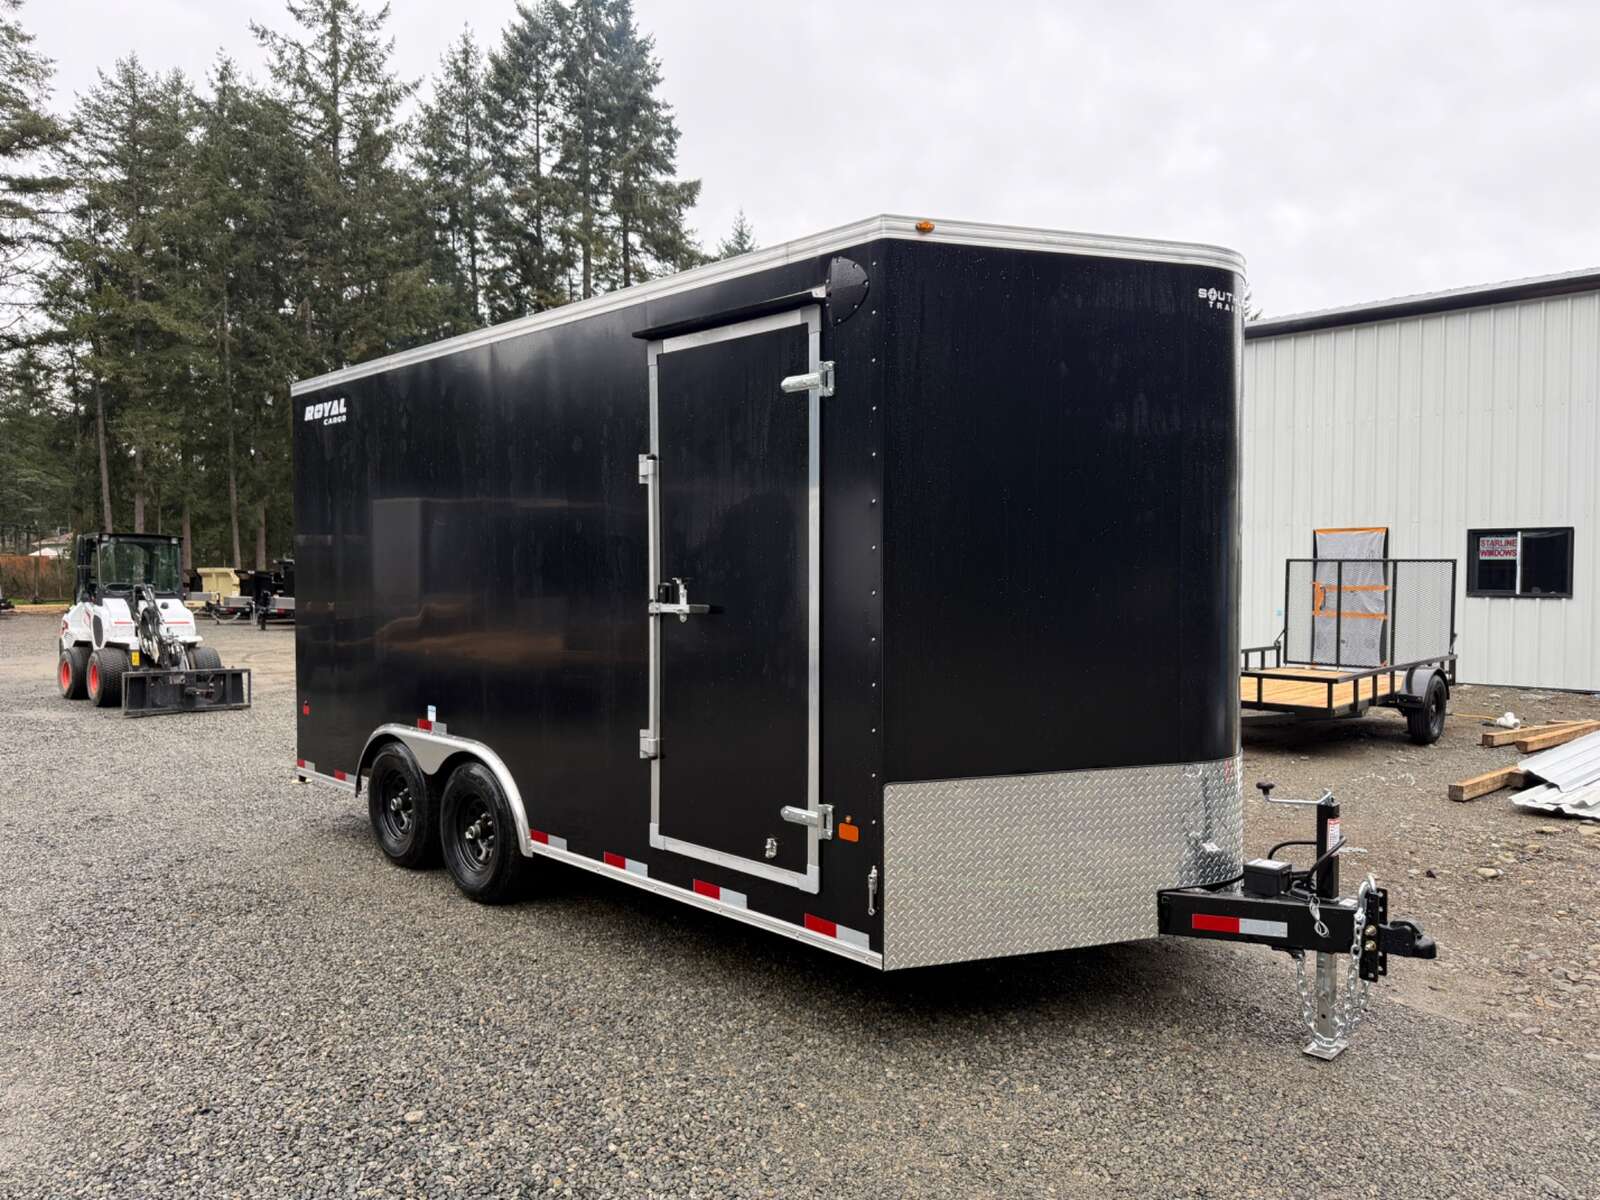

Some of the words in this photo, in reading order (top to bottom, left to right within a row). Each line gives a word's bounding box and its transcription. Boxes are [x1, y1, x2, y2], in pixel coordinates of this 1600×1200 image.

[1208, 301, 1237, 313] TRAI
[304, 398, 347, 421] ROYAL
[323, 414, 347, 426] CARGO
[1480, 539, 1517, 547] STARLINE
[1480, 549, 1517, 557] WINDOWS
